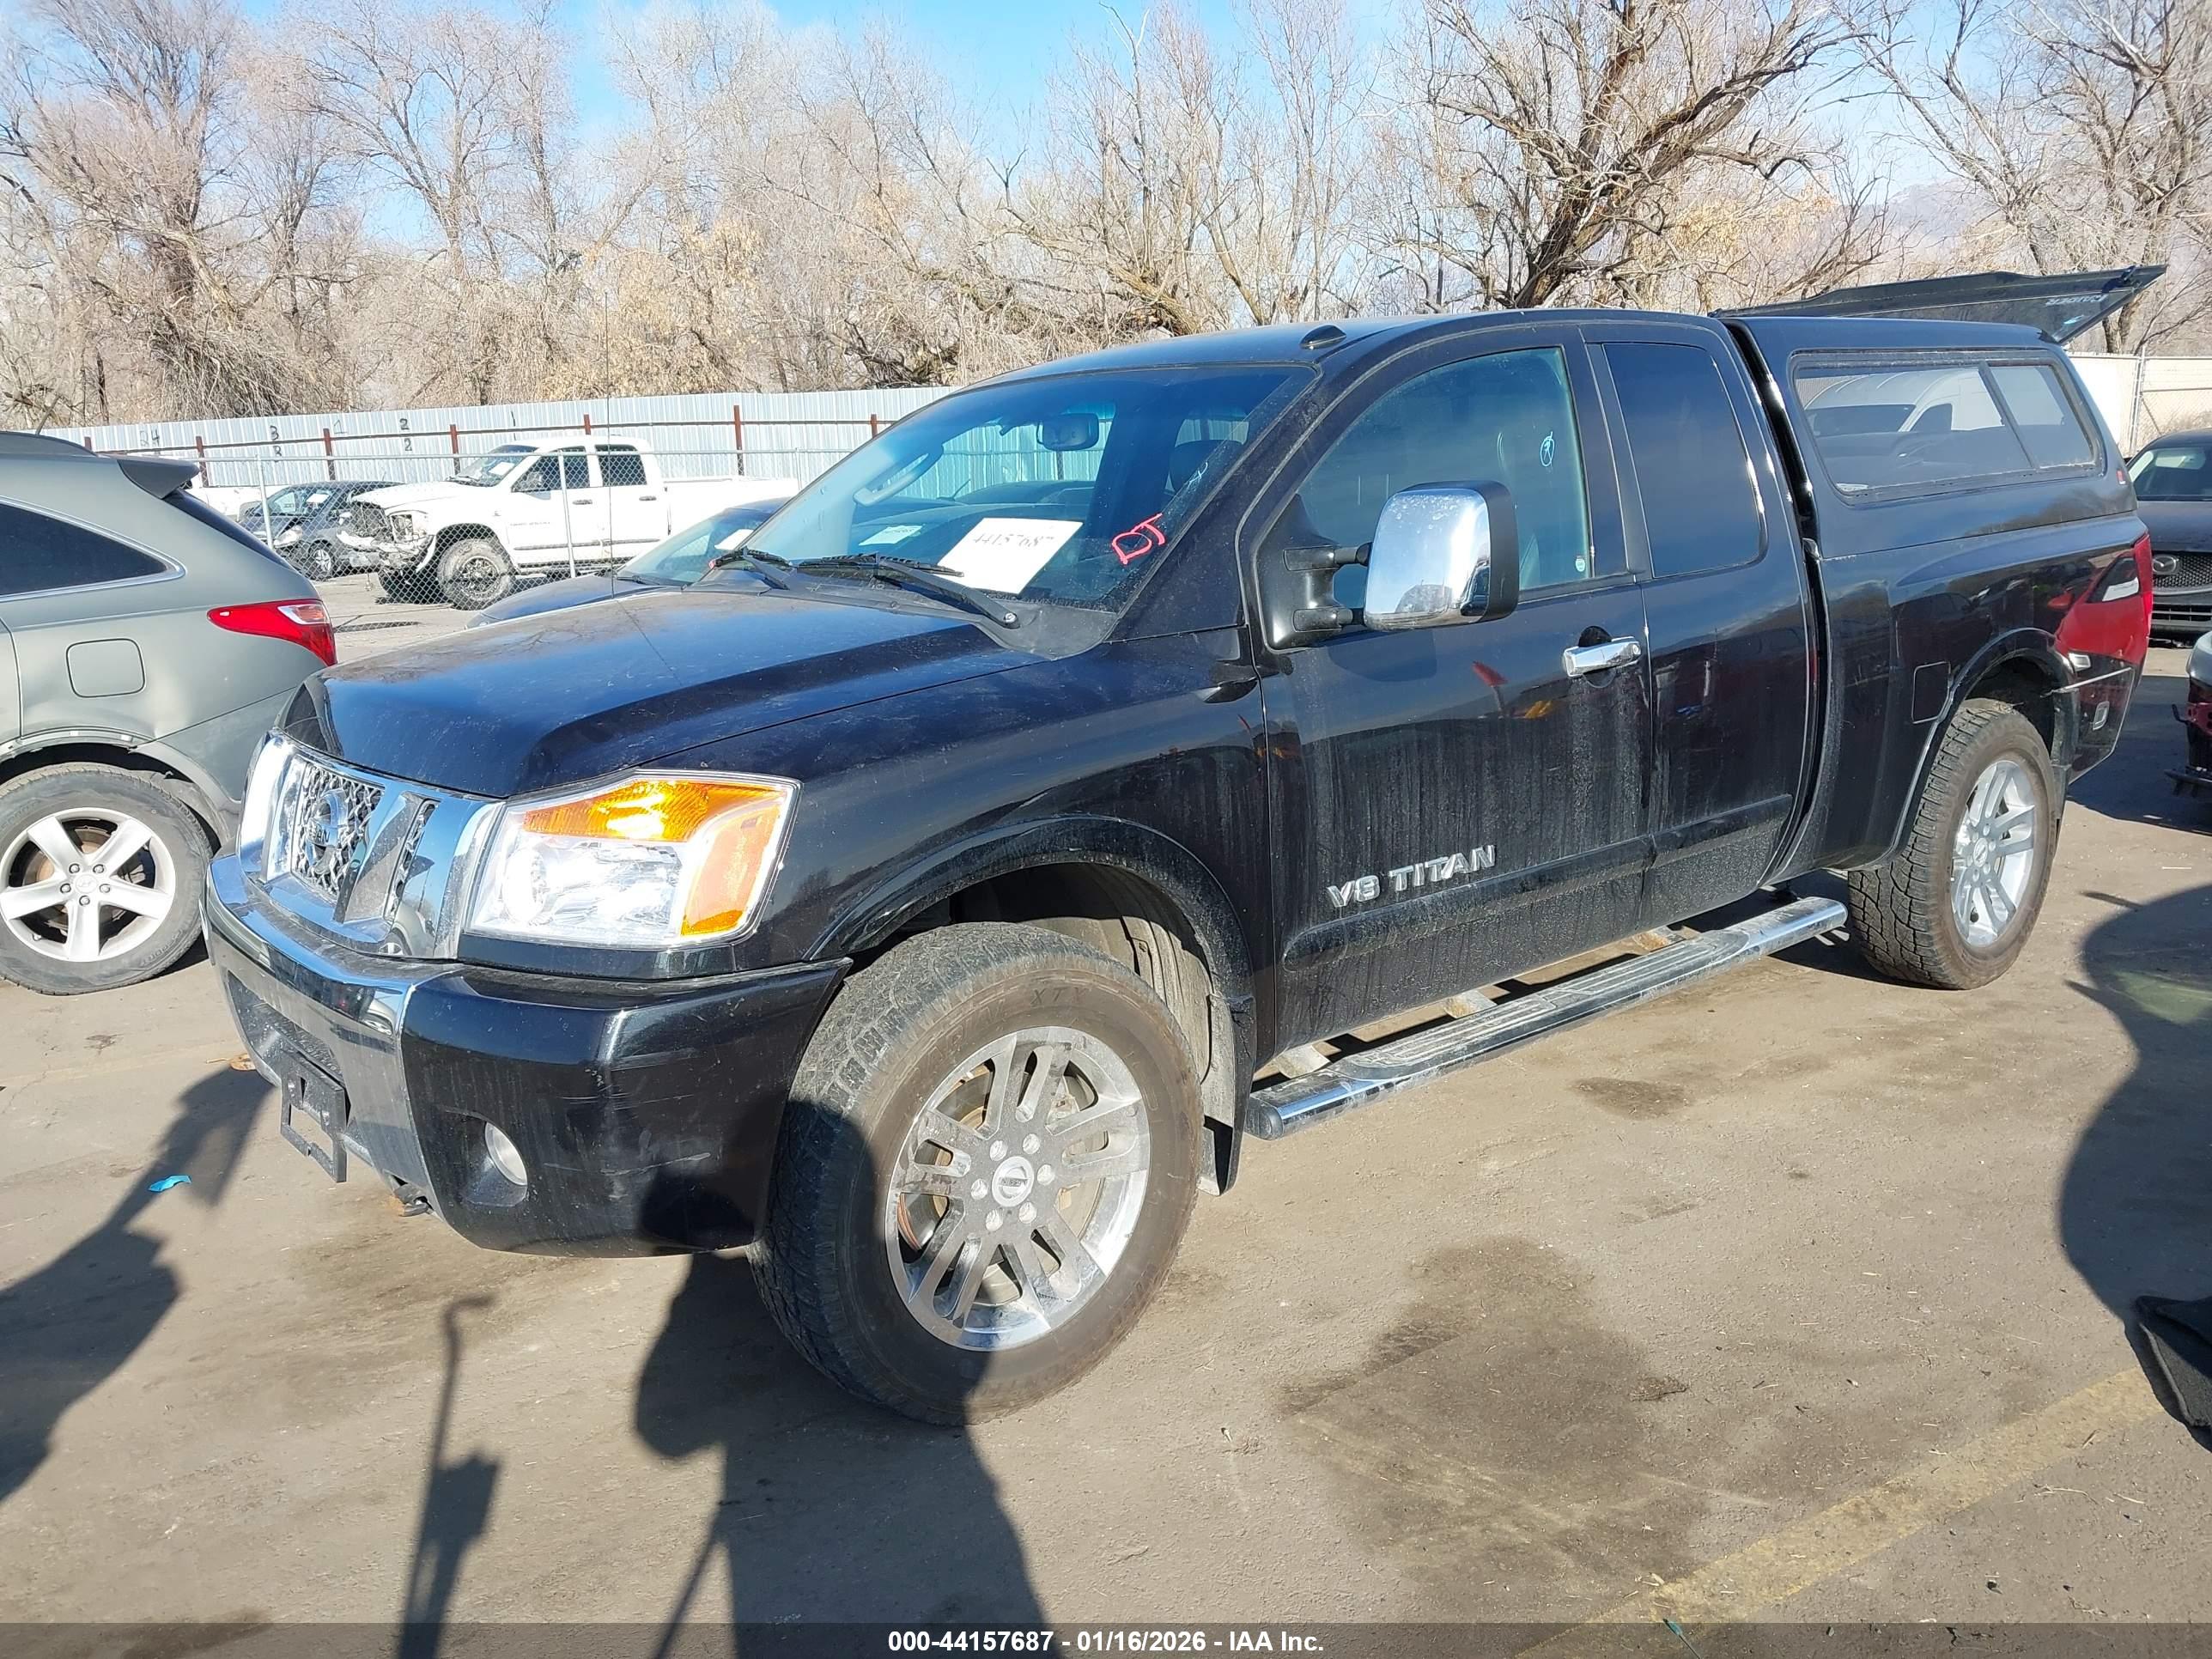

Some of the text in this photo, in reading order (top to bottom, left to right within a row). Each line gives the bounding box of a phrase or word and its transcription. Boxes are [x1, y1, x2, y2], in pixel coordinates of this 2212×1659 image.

[399, 418, 410, 430] 2
[269, 425, 279, 441] 3
[404, 438, 412, 452] 2
[1326, 845, 1497, 908] V8 TITAN
